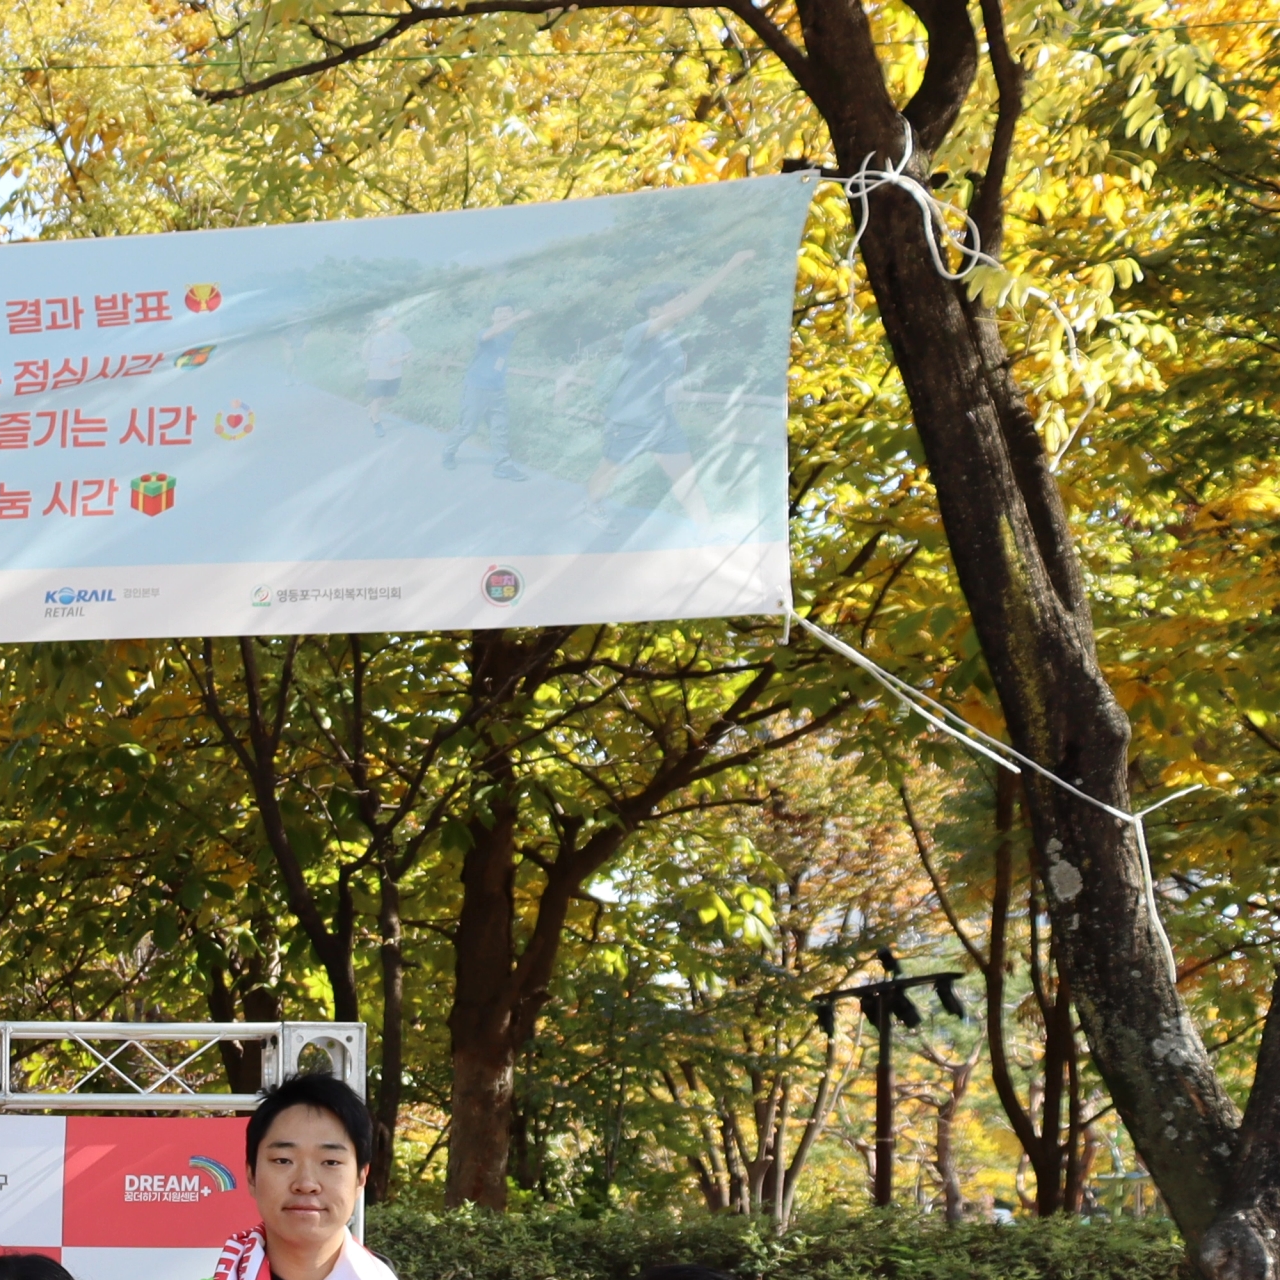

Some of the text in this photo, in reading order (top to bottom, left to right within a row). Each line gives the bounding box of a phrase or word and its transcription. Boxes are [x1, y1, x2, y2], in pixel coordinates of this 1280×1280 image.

[8, 297, 84, 335] 결과
[95, 291, 171, 327] 발표
[15, 354, 164, 396] 점심시간
[119, 406, 197, 446] 시간
[42, 479, 119, 518] 시간
[44, 587, 118, 605] KORAIL
[44, 606, 86, 619] RETAIL
[123, 1191, 200, 1203] 꿈더하기 지원센터
